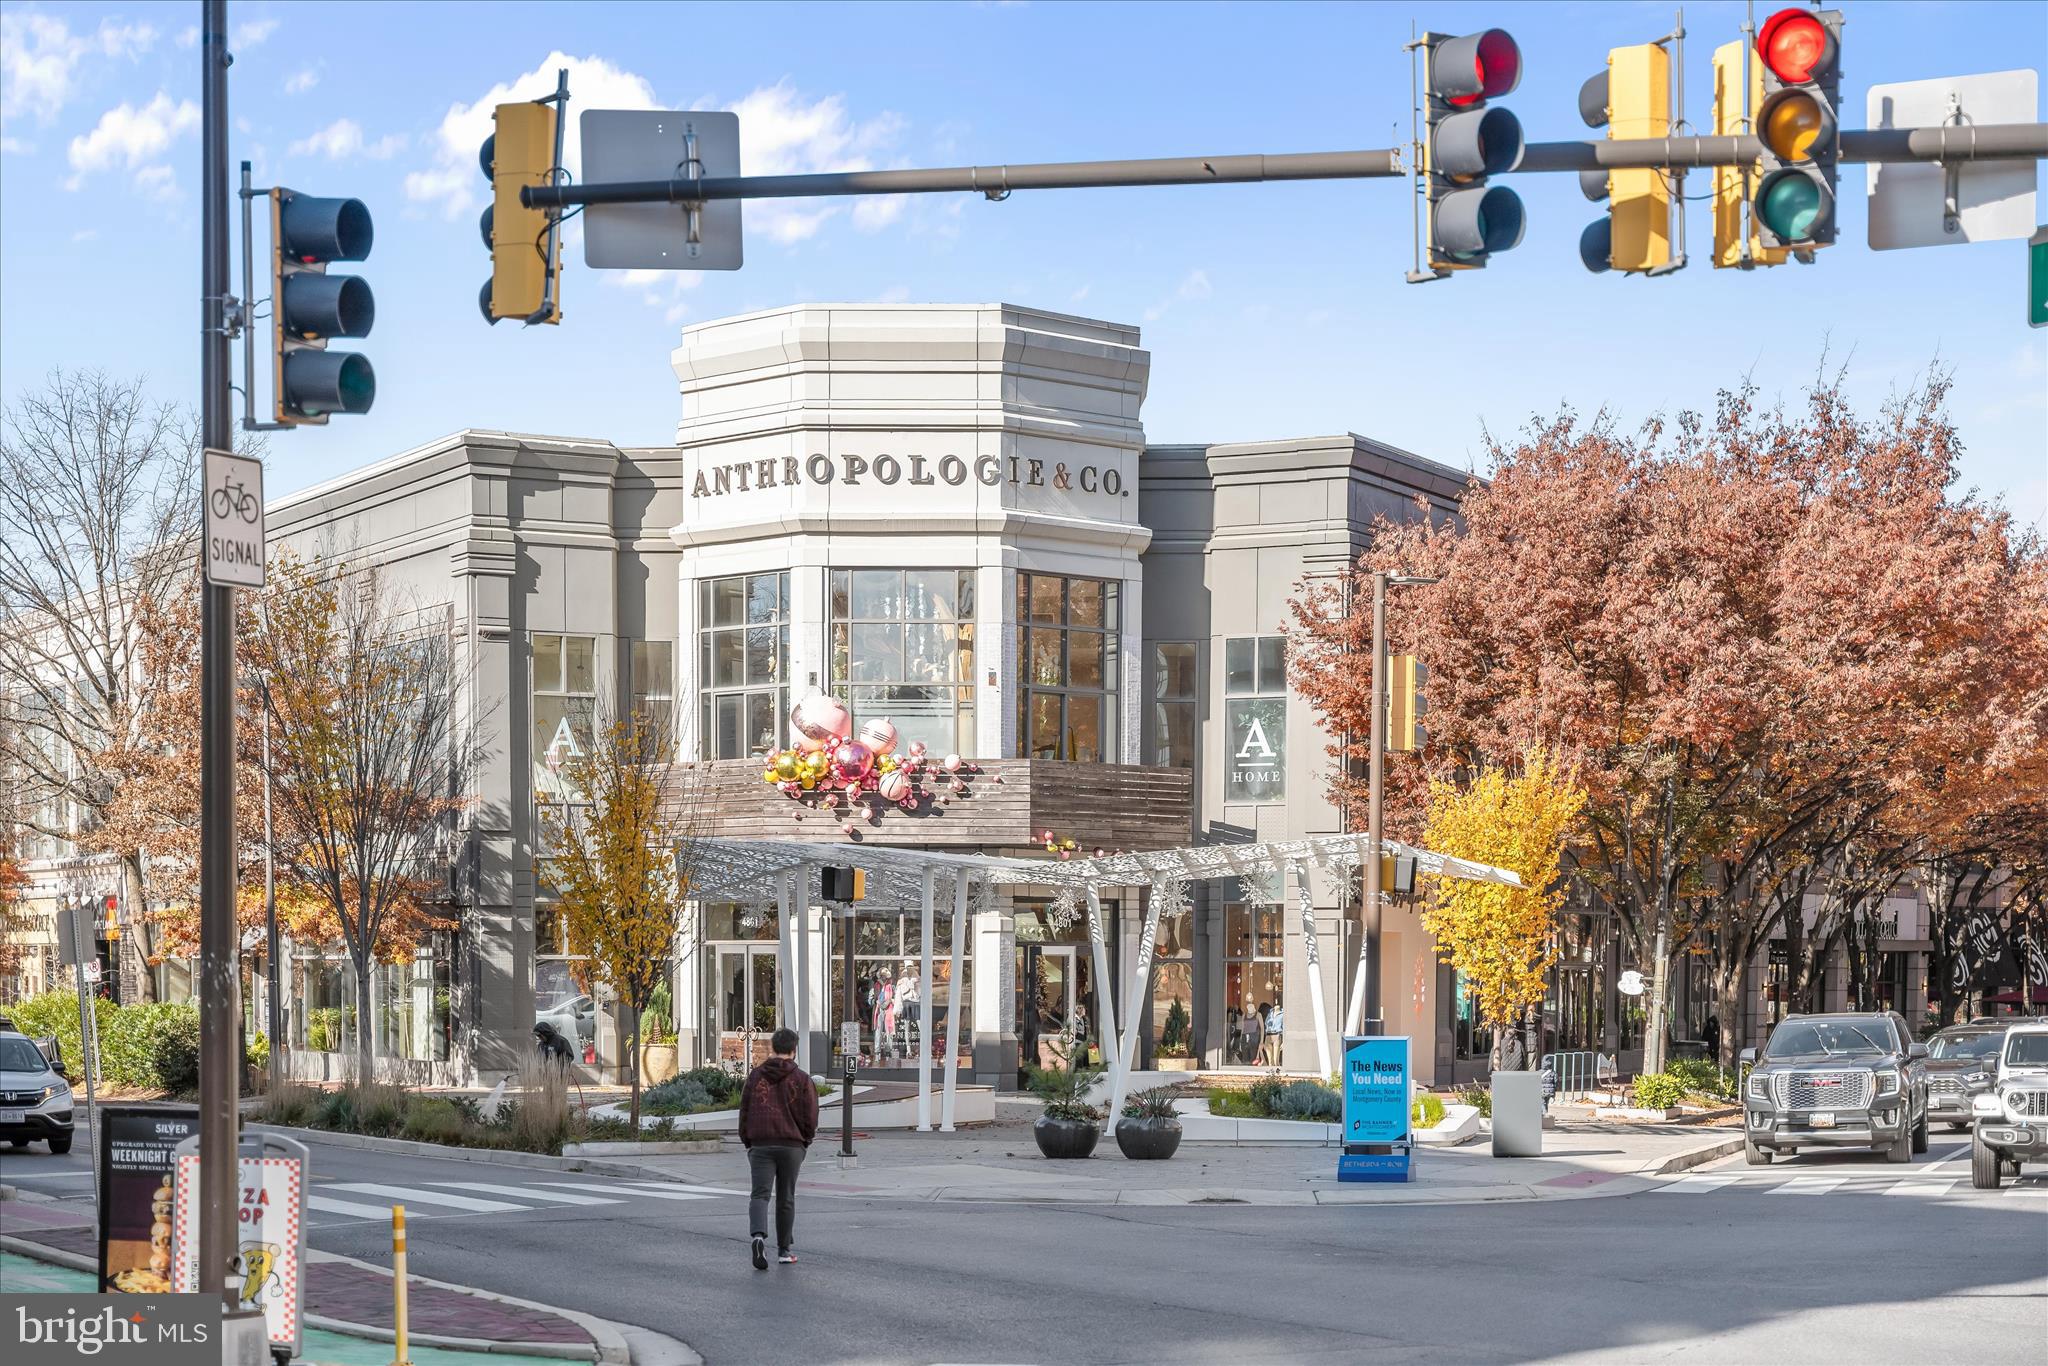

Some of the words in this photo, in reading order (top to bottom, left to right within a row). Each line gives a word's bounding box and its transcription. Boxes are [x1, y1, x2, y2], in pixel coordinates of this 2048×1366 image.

[212, 536, 262, 567] SIGNAL
[1236, 718, 1277, 758] A
[1232, 771, 1281, 783] HOME
[1351, 1060, 1371, 1072] The
[1374, 1060, 1403, 1072] News
[1352, 1073, 1371, 1085] You
[1374, 1073, 1402, 1085] Need
[1352, 1095, 1383, 1104] Montgomery
[1384, 1095, 1402, 1104] County
[155, 1123, 189, 1135] SILVER
[111, 1149, 167, 1163] WEEKNIGHT
